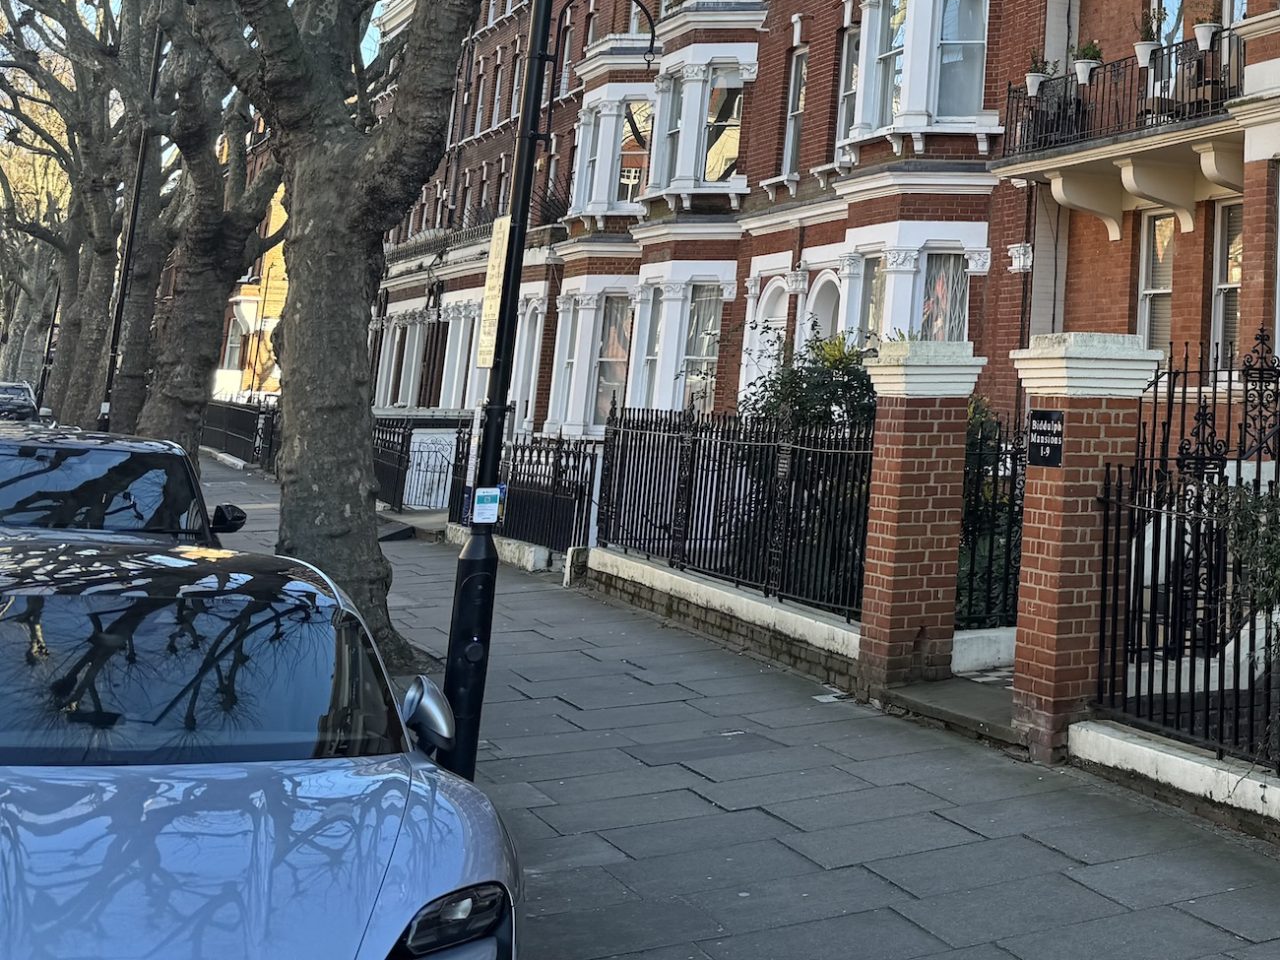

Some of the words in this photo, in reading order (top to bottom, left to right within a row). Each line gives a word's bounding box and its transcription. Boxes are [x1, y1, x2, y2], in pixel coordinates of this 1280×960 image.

[1032, 419, 1062, 434] Biddulph
[1030, 432, 1062, 445] Mansions
[1040, 445, 1051, 457] 1-9
